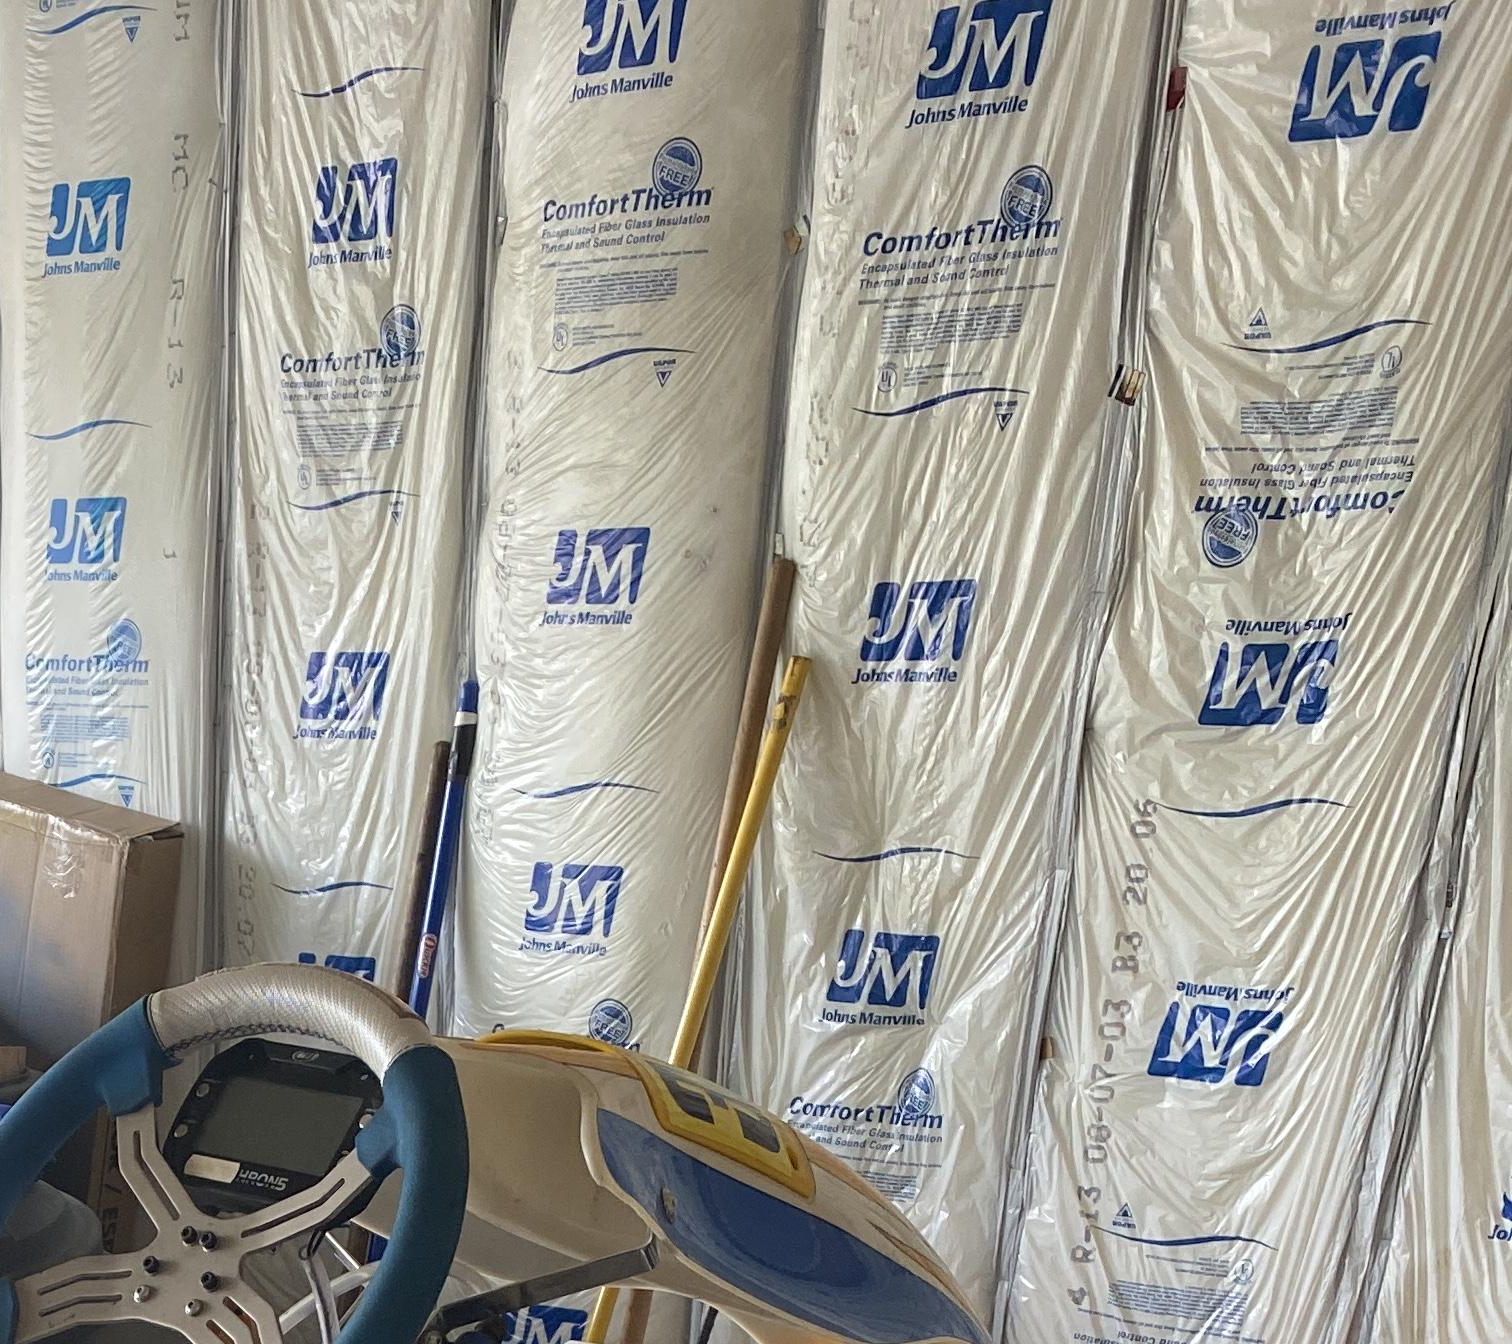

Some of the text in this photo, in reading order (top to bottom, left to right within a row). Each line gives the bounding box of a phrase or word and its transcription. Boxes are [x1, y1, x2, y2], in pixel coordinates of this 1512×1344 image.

[1315, 0, 1455, 37] Johns Manville
[576, 0, 687, 75] JM
[916, 0, 1054, 99] JM
[569, 71, 674, 103] Johns Manville
[1288, 30, 1442, 142] JM
[905, 95, 1029, 129] Johns Manville
[46, 176, 131, 257] JM
[311, 157, 398, 244] JM
[543, 187, 713, 222] ComfortTherm
[593, 233, 624, 248] Sound
[625, 230, 666, 246] Control
[624, 218, 653, 231] Glass
[655, 213, 711, 228] Insulation
[863, 217, 1062, 257] ComfortTherm
[41, 256, 121, 278] Johns Manville
[308, 246, 392, 268] Johns Manville
[860, 257, 936, 275] Encapsulated
[968, 250, 999, 264] Glass
[1001, 245, 1059, 260] Insulation
[858, 275, 911, 291] Thermal
[912, 273, 929, 285] and
[1250, 463, 1296, 475] Control
[1339, 456, 1364, 469] and
[1365, 453, 1416, 467] Thermal
[1199, 477, 1260, 489] Insulation
[1262, 477, 1296, 490] Glass
[46, 497, 128, 564] JM
[546, 527, 651, 605] JM
[859, 579, 978, 662] JM
[1225, 612, 1354, 637] Johns Manville
[299, 651, 390, 721] JM
[851, 666, 958, 684] Johns Manville
[1198, 639, 1339, 727] JM
[524, 861, 625, 938] JM
[1122, 862, 1150, 905] 20
[826, 928, 940, 1010] JM
[1176, 980, 1239, 1002] Manville
[819, 1007, 925, 1026] Johns Manville
[1147, 1000, 1284, 1087] JM
[1084, 1000, 1133, 1164] 08-07-03
[789, 1096, 943, 1129] ComfortTherm
[834, 1136, 866, 1149] Sound
[1070, 1185, 1102, 1265] R-13
